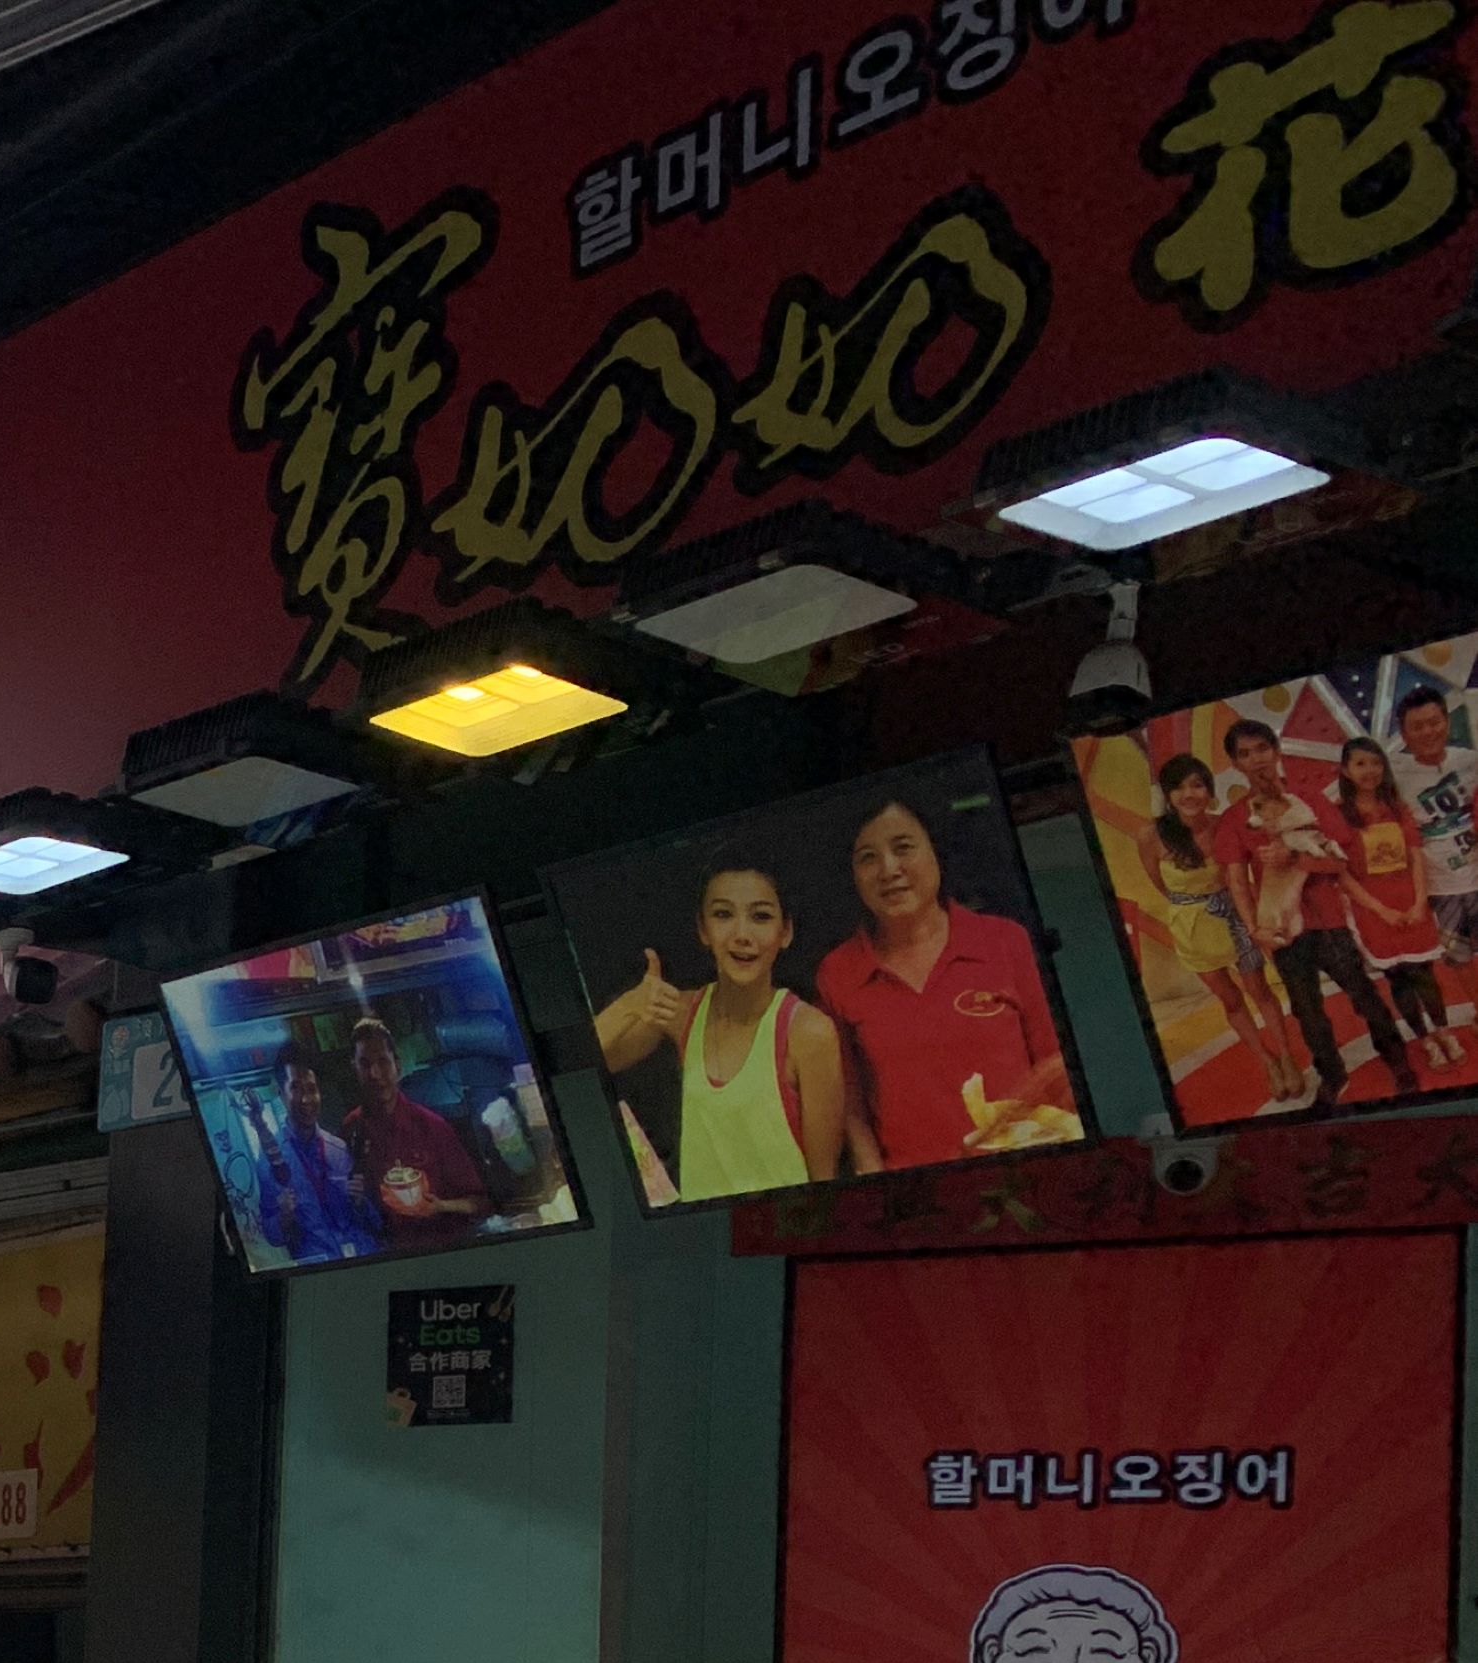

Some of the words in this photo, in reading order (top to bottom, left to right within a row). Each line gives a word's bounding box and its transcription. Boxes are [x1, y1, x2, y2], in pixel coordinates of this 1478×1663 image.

[573, 0, 1124, 268] 할머니오징
[420, 1299, 483, 1322] Uber
[419, 1324, 482, 1346] Eats
[408, 1349, 492, 1372] 合作商家
[929, 1450, 1294, 1507] 할머니오징어
